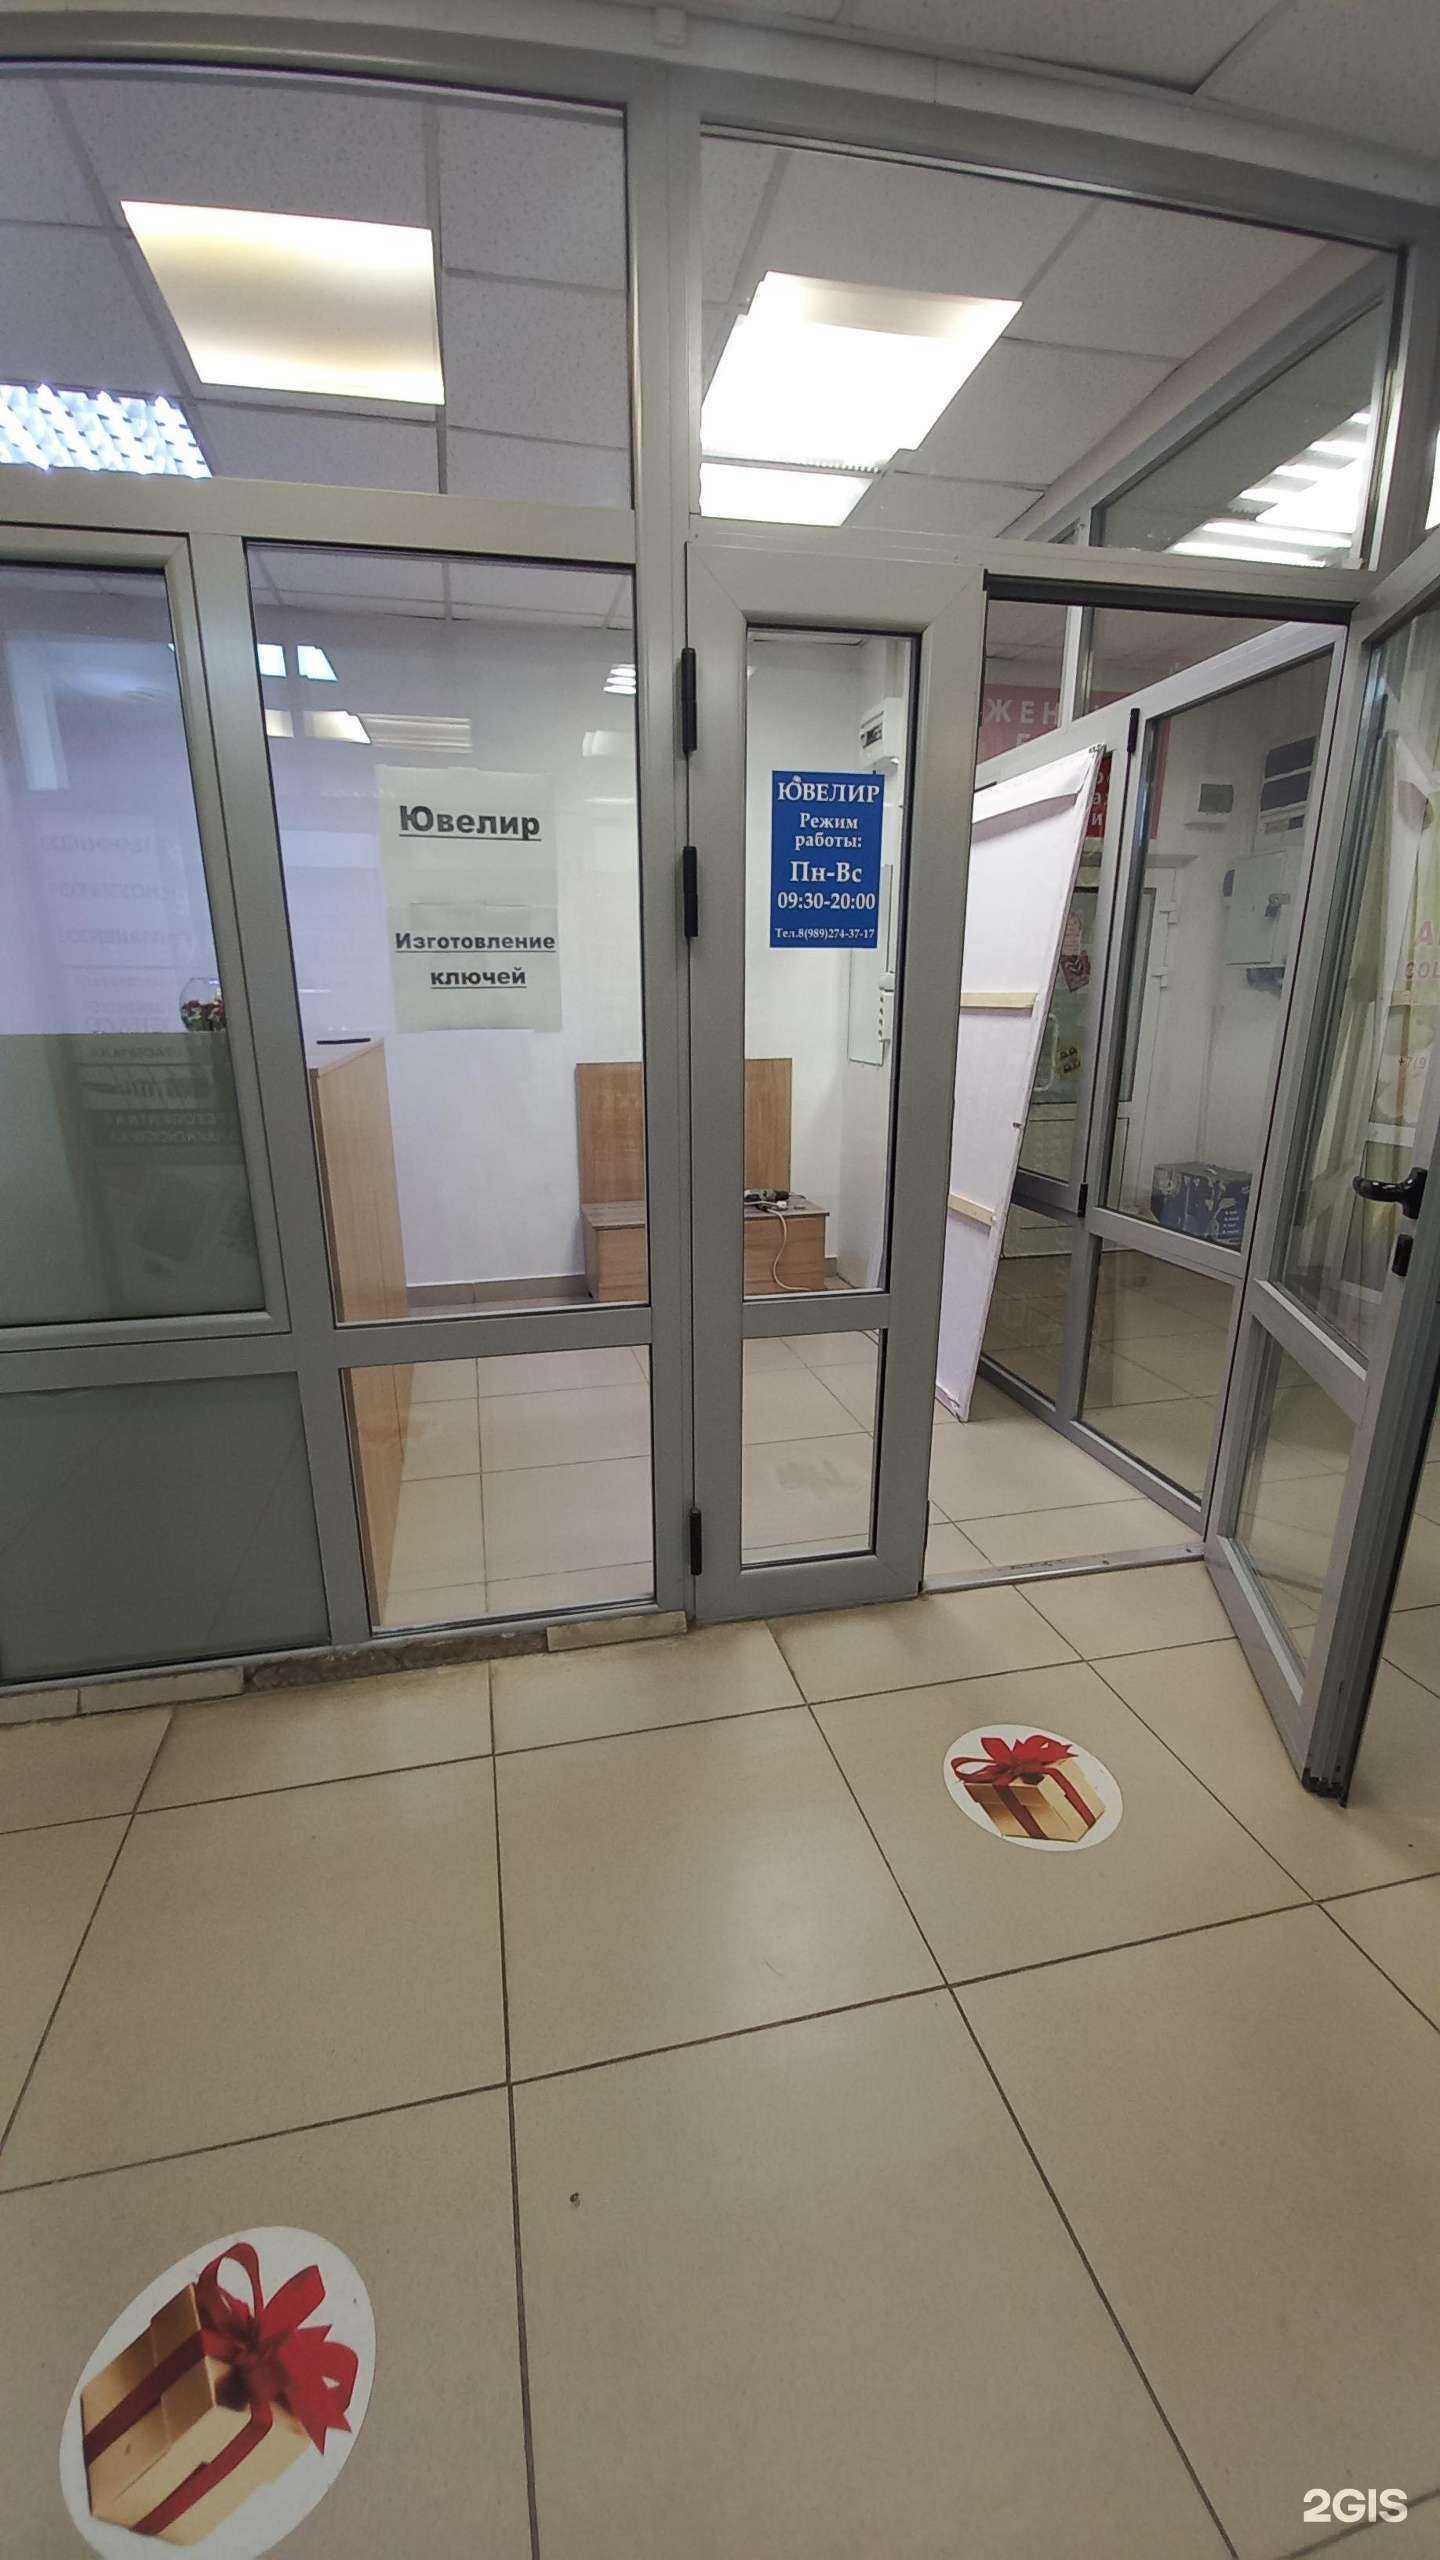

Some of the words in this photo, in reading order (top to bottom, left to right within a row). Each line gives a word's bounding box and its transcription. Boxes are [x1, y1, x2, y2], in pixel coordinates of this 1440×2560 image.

[778, 780, 880, 804] ЮВЕЛИР
[400, 805, 541, 840] Ювелир
[799, 812, 859, 830] Режим
[794, 832, 863, 851] работы:
[789, 861, 863, 883] Пн-Вс
[777, 891, 876, 910] 09:30-20:00
[395, 932, 556, 950] Изготовление
[775, 927, 875, 942] Тел.8(989)274-37-17
[430, 967, 527, 986] ключей
